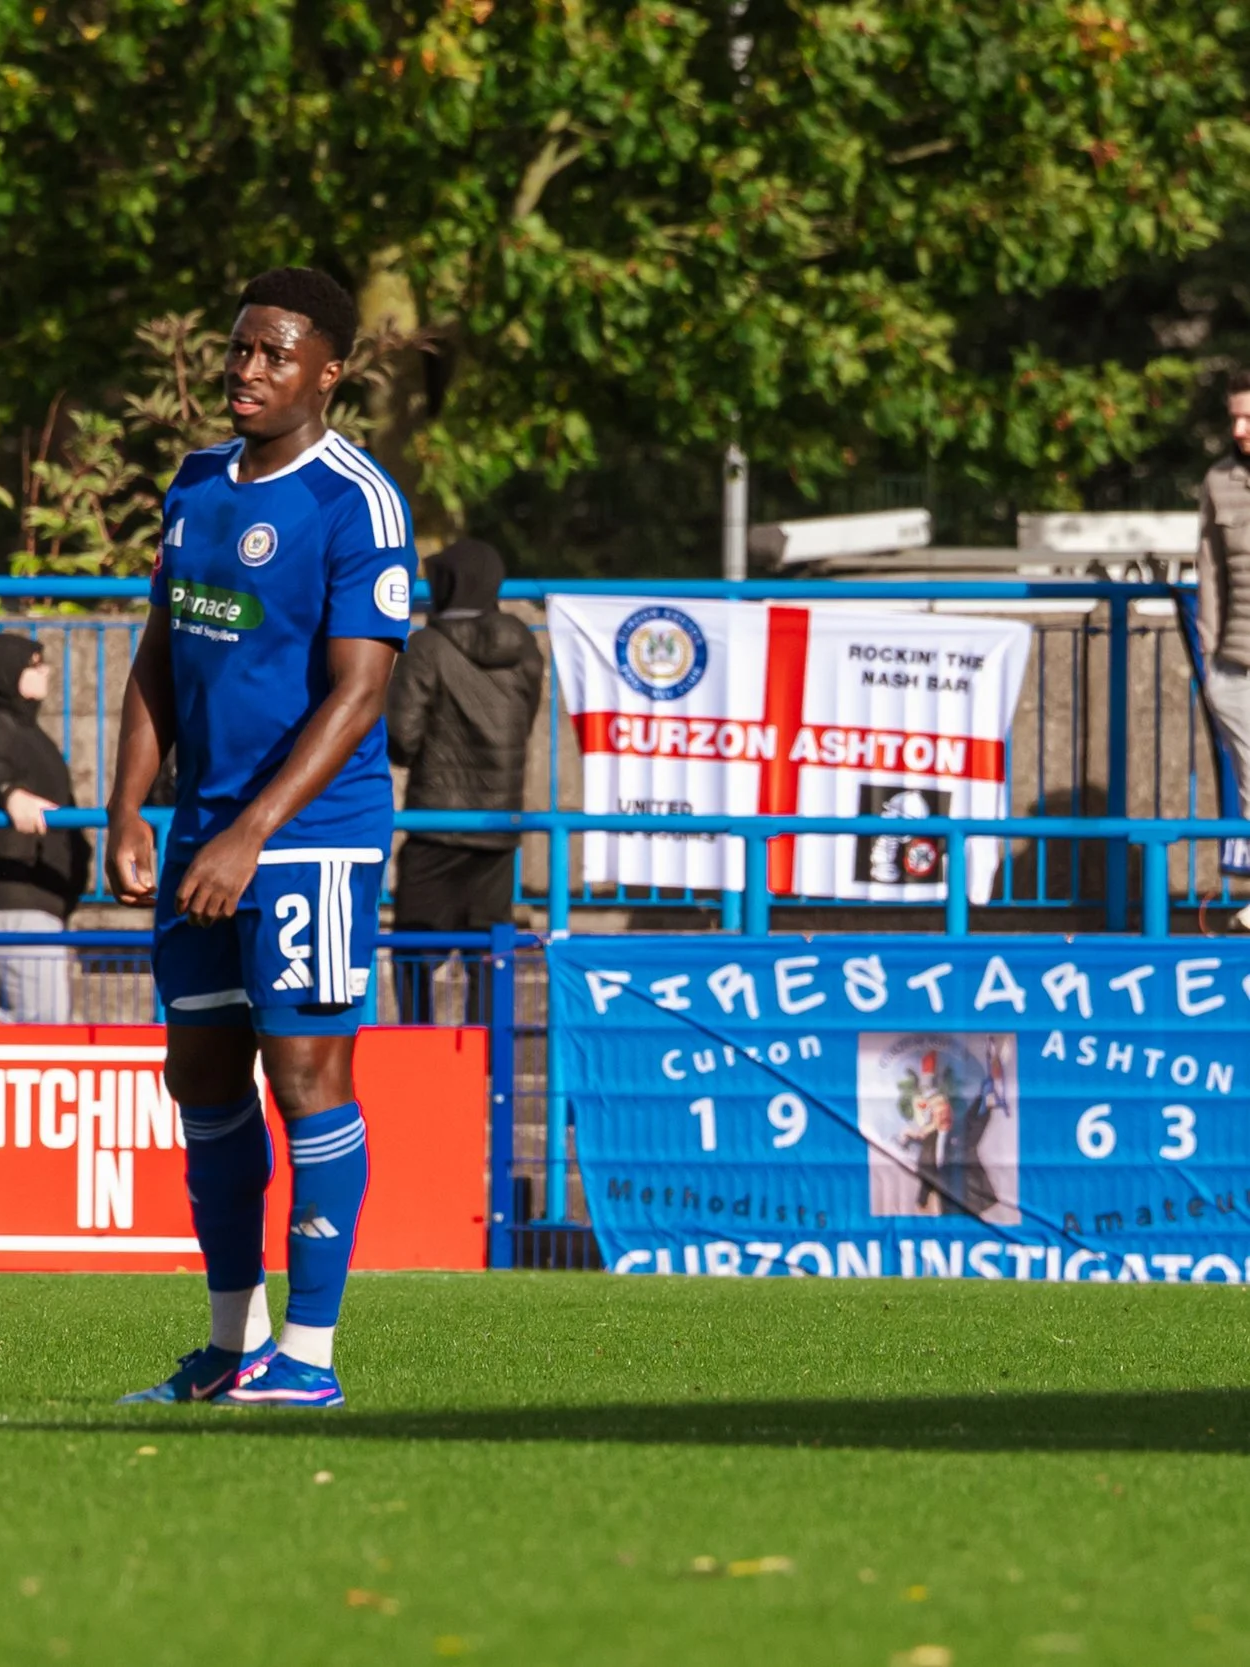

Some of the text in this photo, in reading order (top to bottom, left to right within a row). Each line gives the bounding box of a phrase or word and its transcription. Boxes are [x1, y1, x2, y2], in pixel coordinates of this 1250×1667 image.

[848, 644, 985, 671] ROCKIN' THE
[862, 670, 971, 694] NASH BAR
[608, 714, 967, 775] CURZON ASHTON
[617, 797, 694, 815] UNITED
[274, 893, 311, 961] 2
[585, 954, 1250, 1020] FIRESTARTE
[1041, 1030, 1234, 1095] ASHTON
[77, 1149, 134, 1229] IN
[607, 1176, 1250, 1236] Methodists Amateu
[899, 1239, 1250, 1284] INSTIGATO
